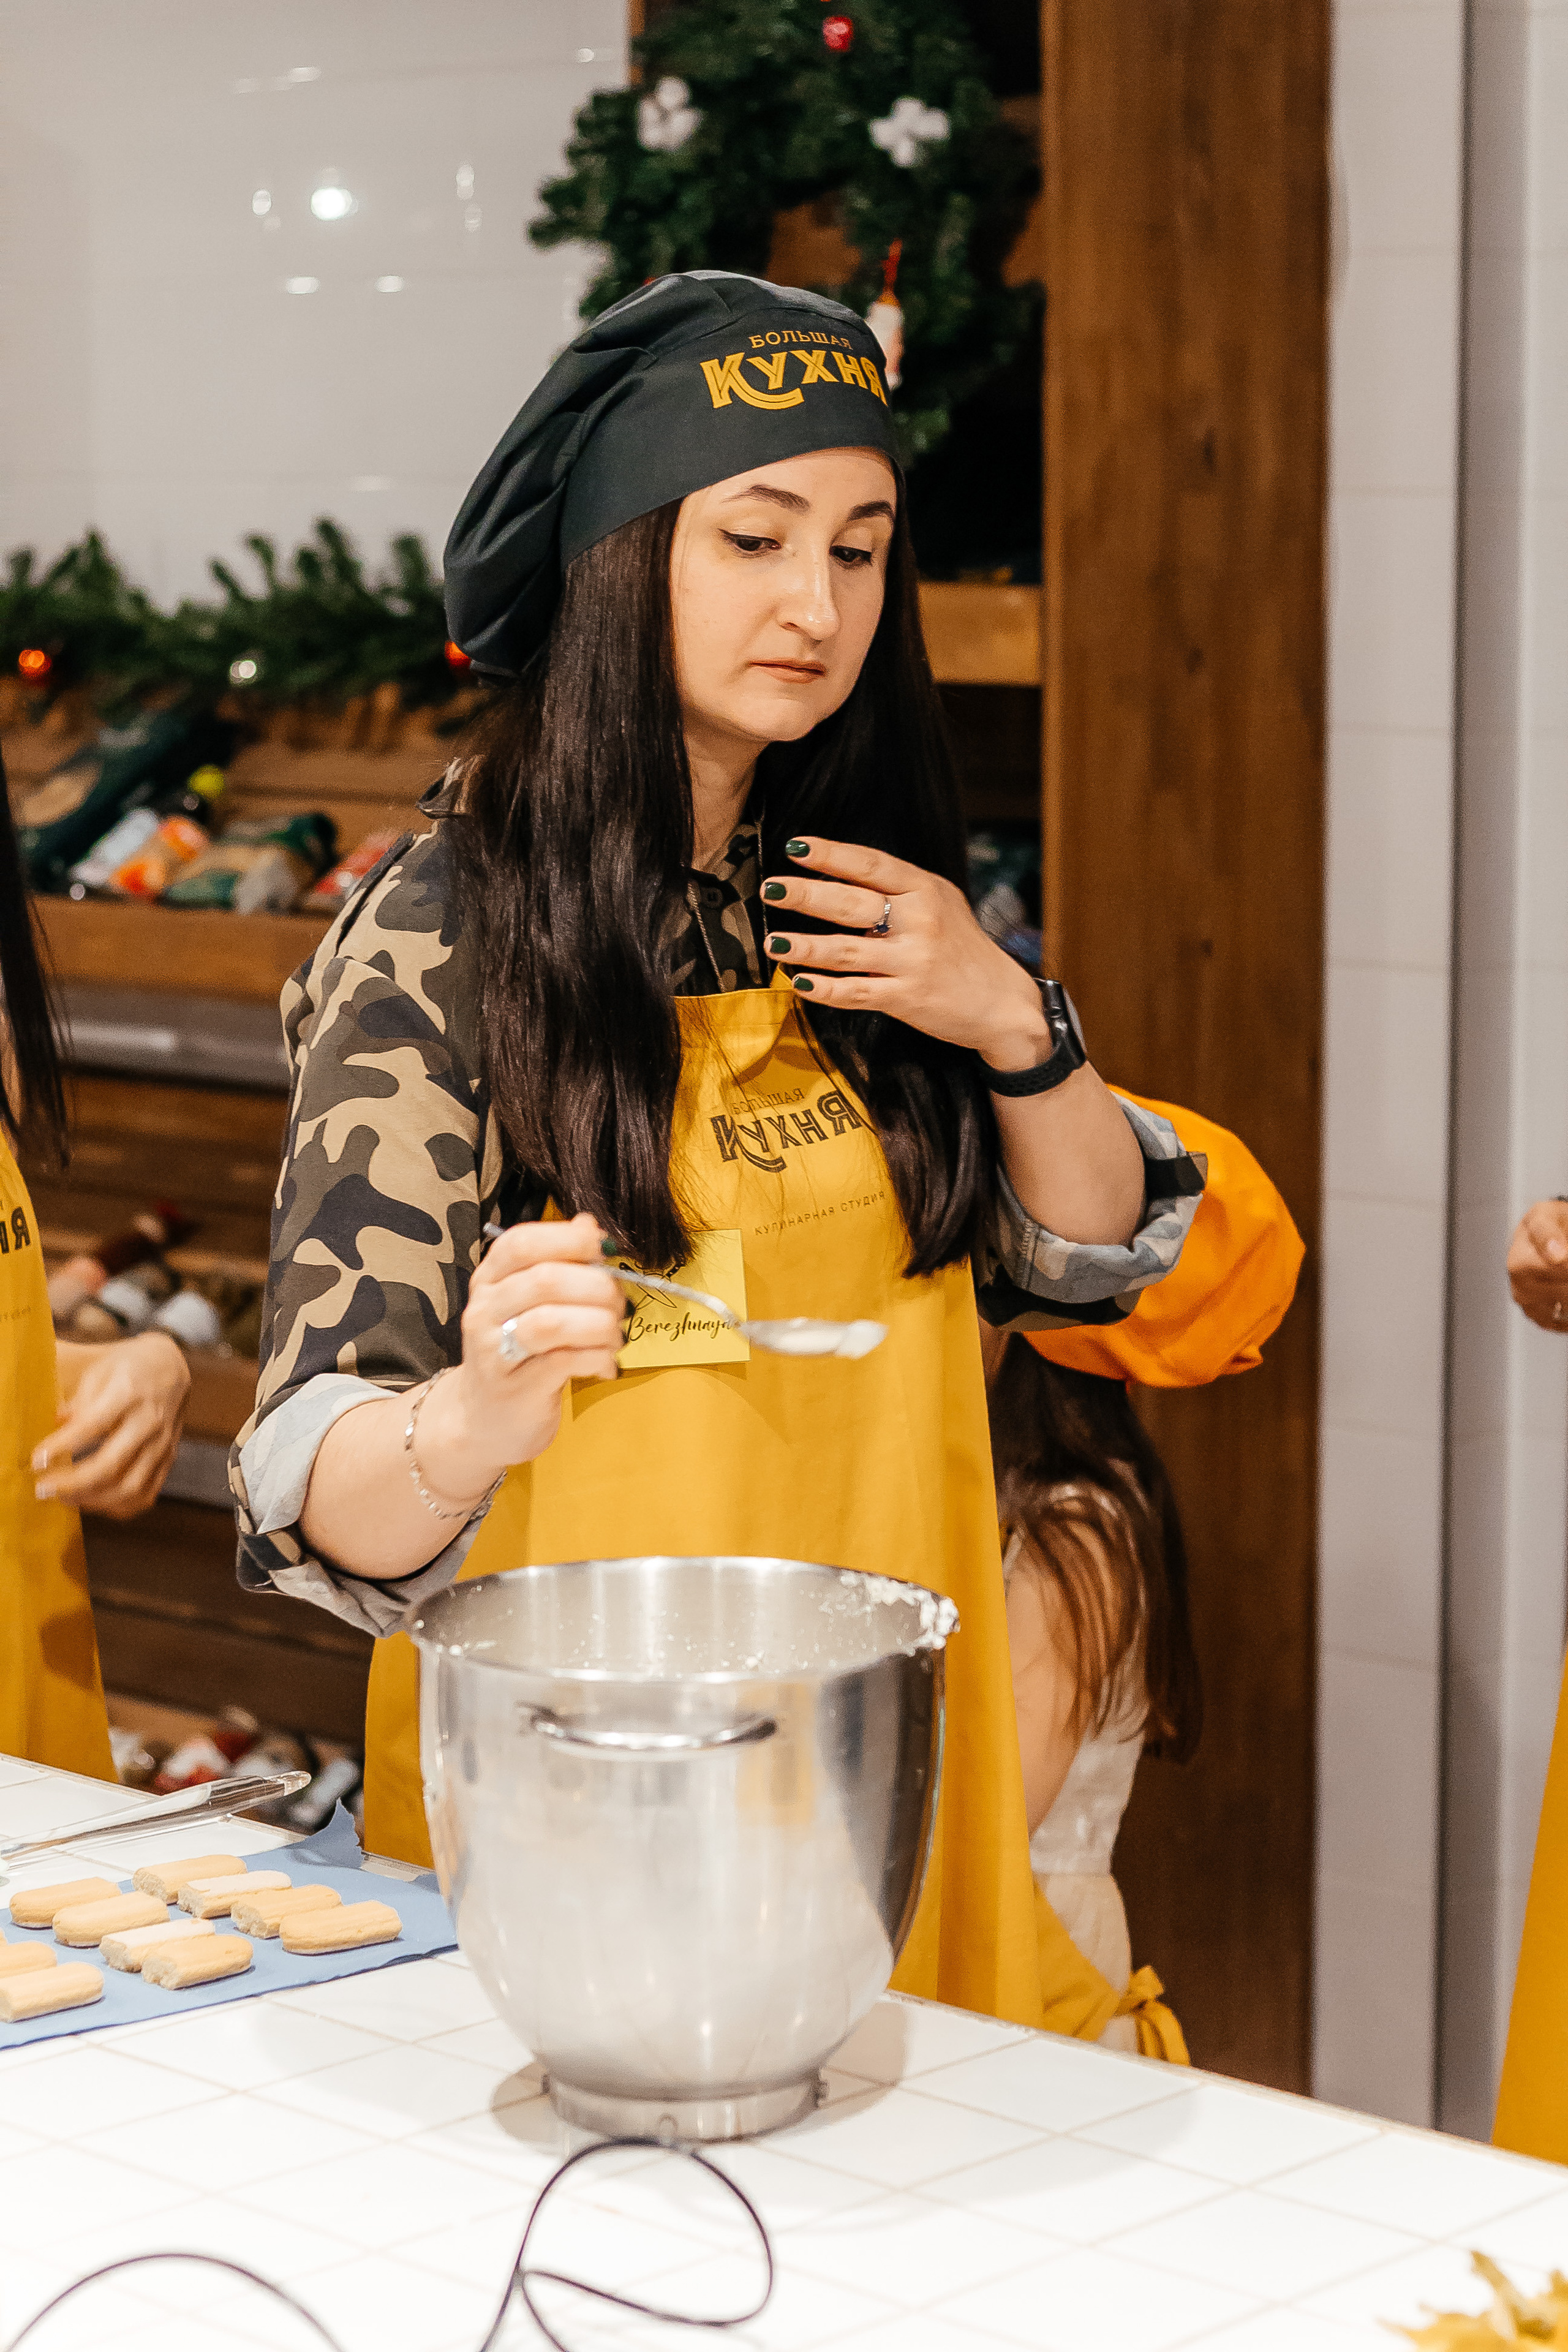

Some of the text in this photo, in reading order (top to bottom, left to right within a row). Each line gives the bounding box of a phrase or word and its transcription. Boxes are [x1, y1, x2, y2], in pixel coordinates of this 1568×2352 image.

[748, 330, 853, 350] БОЛЬШАЯ
[699, 350, 888, 410] КУХНЯ
[710, 1090, 862, 1173] КУХНЯ
[754, 1190, 886, 1235] КУЛИНАРНАЯ СТУДИЯ
